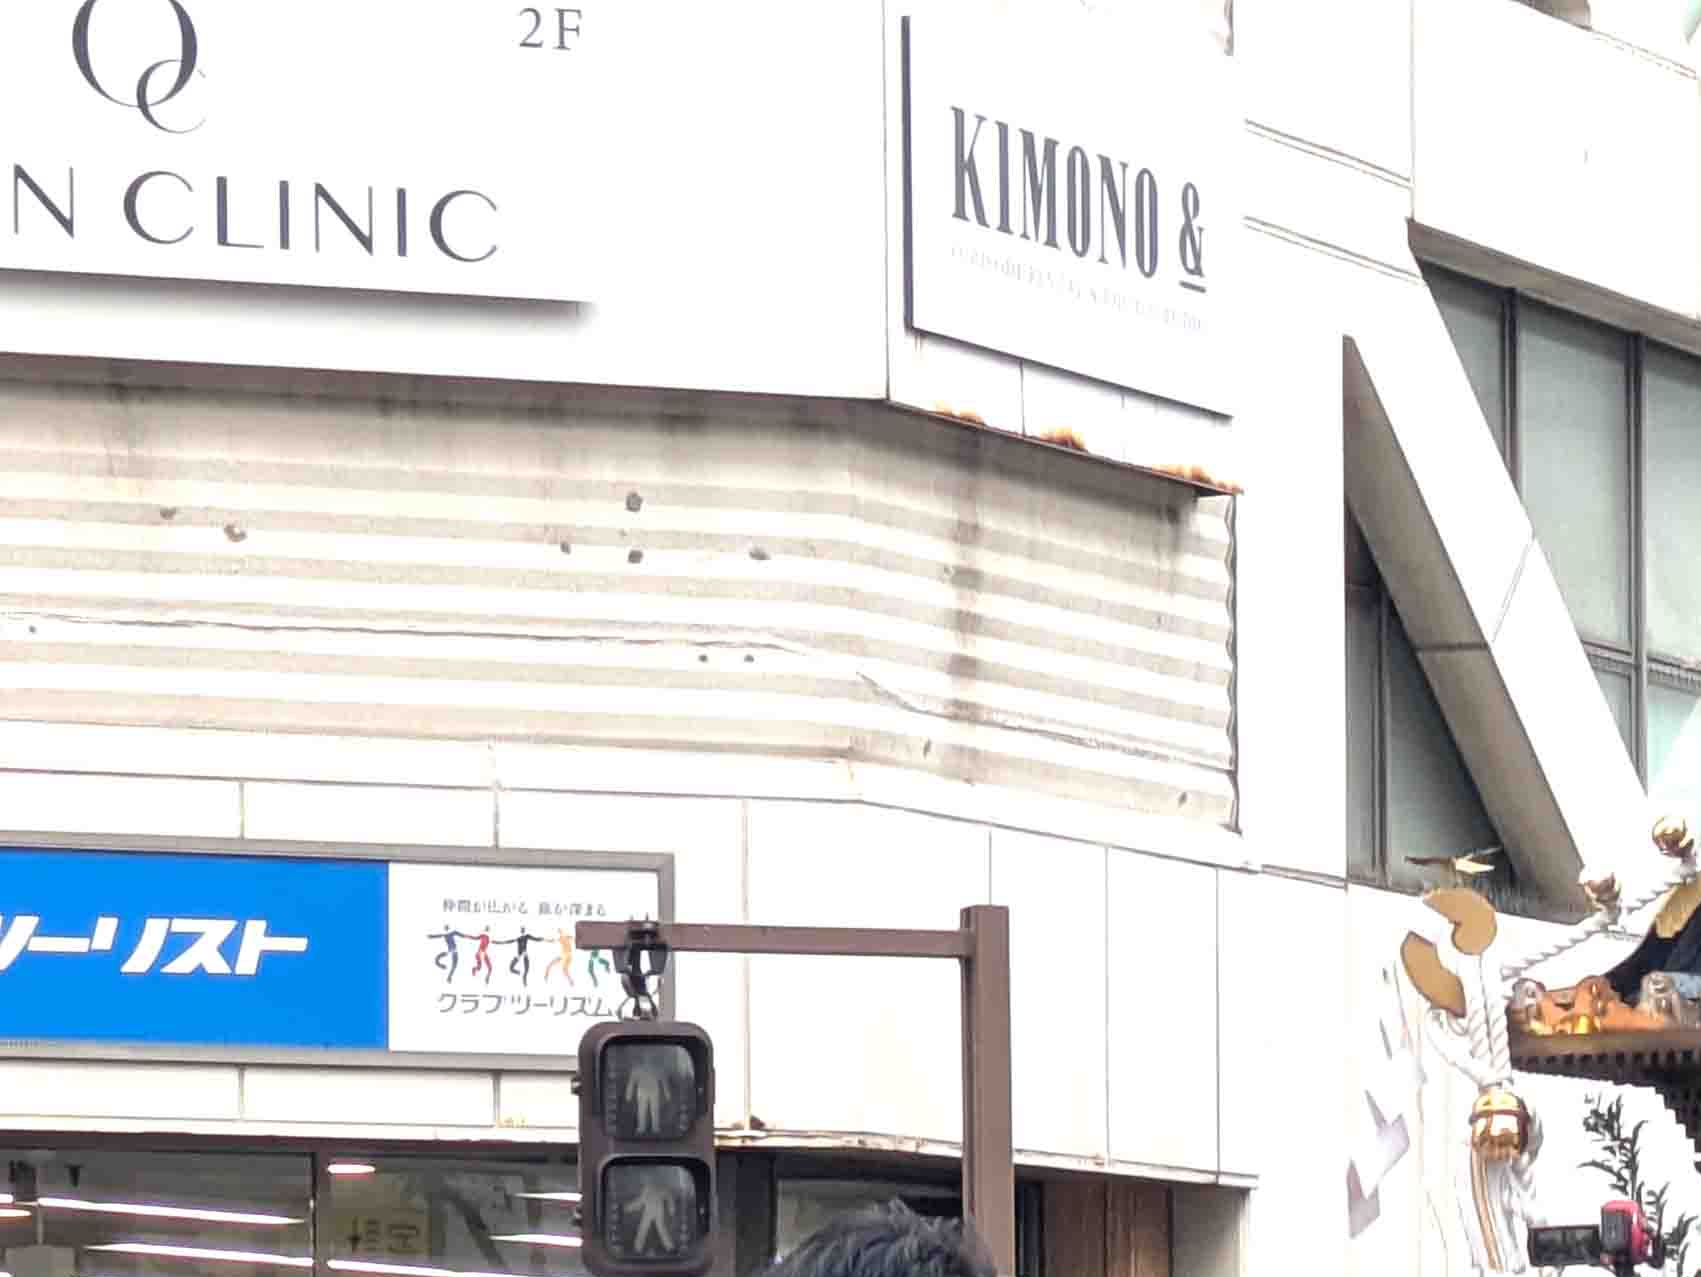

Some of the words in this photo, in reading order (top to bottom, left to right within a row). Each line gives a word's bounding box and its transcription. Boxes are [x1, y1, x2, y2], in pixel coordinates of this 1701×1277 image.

[518, 7, 583, 51] 2F
[123, 170, 498, 263] CLINIC
[950, 105, 1159, 279] KIMONO
[1179, 181, 1207, 280] &
